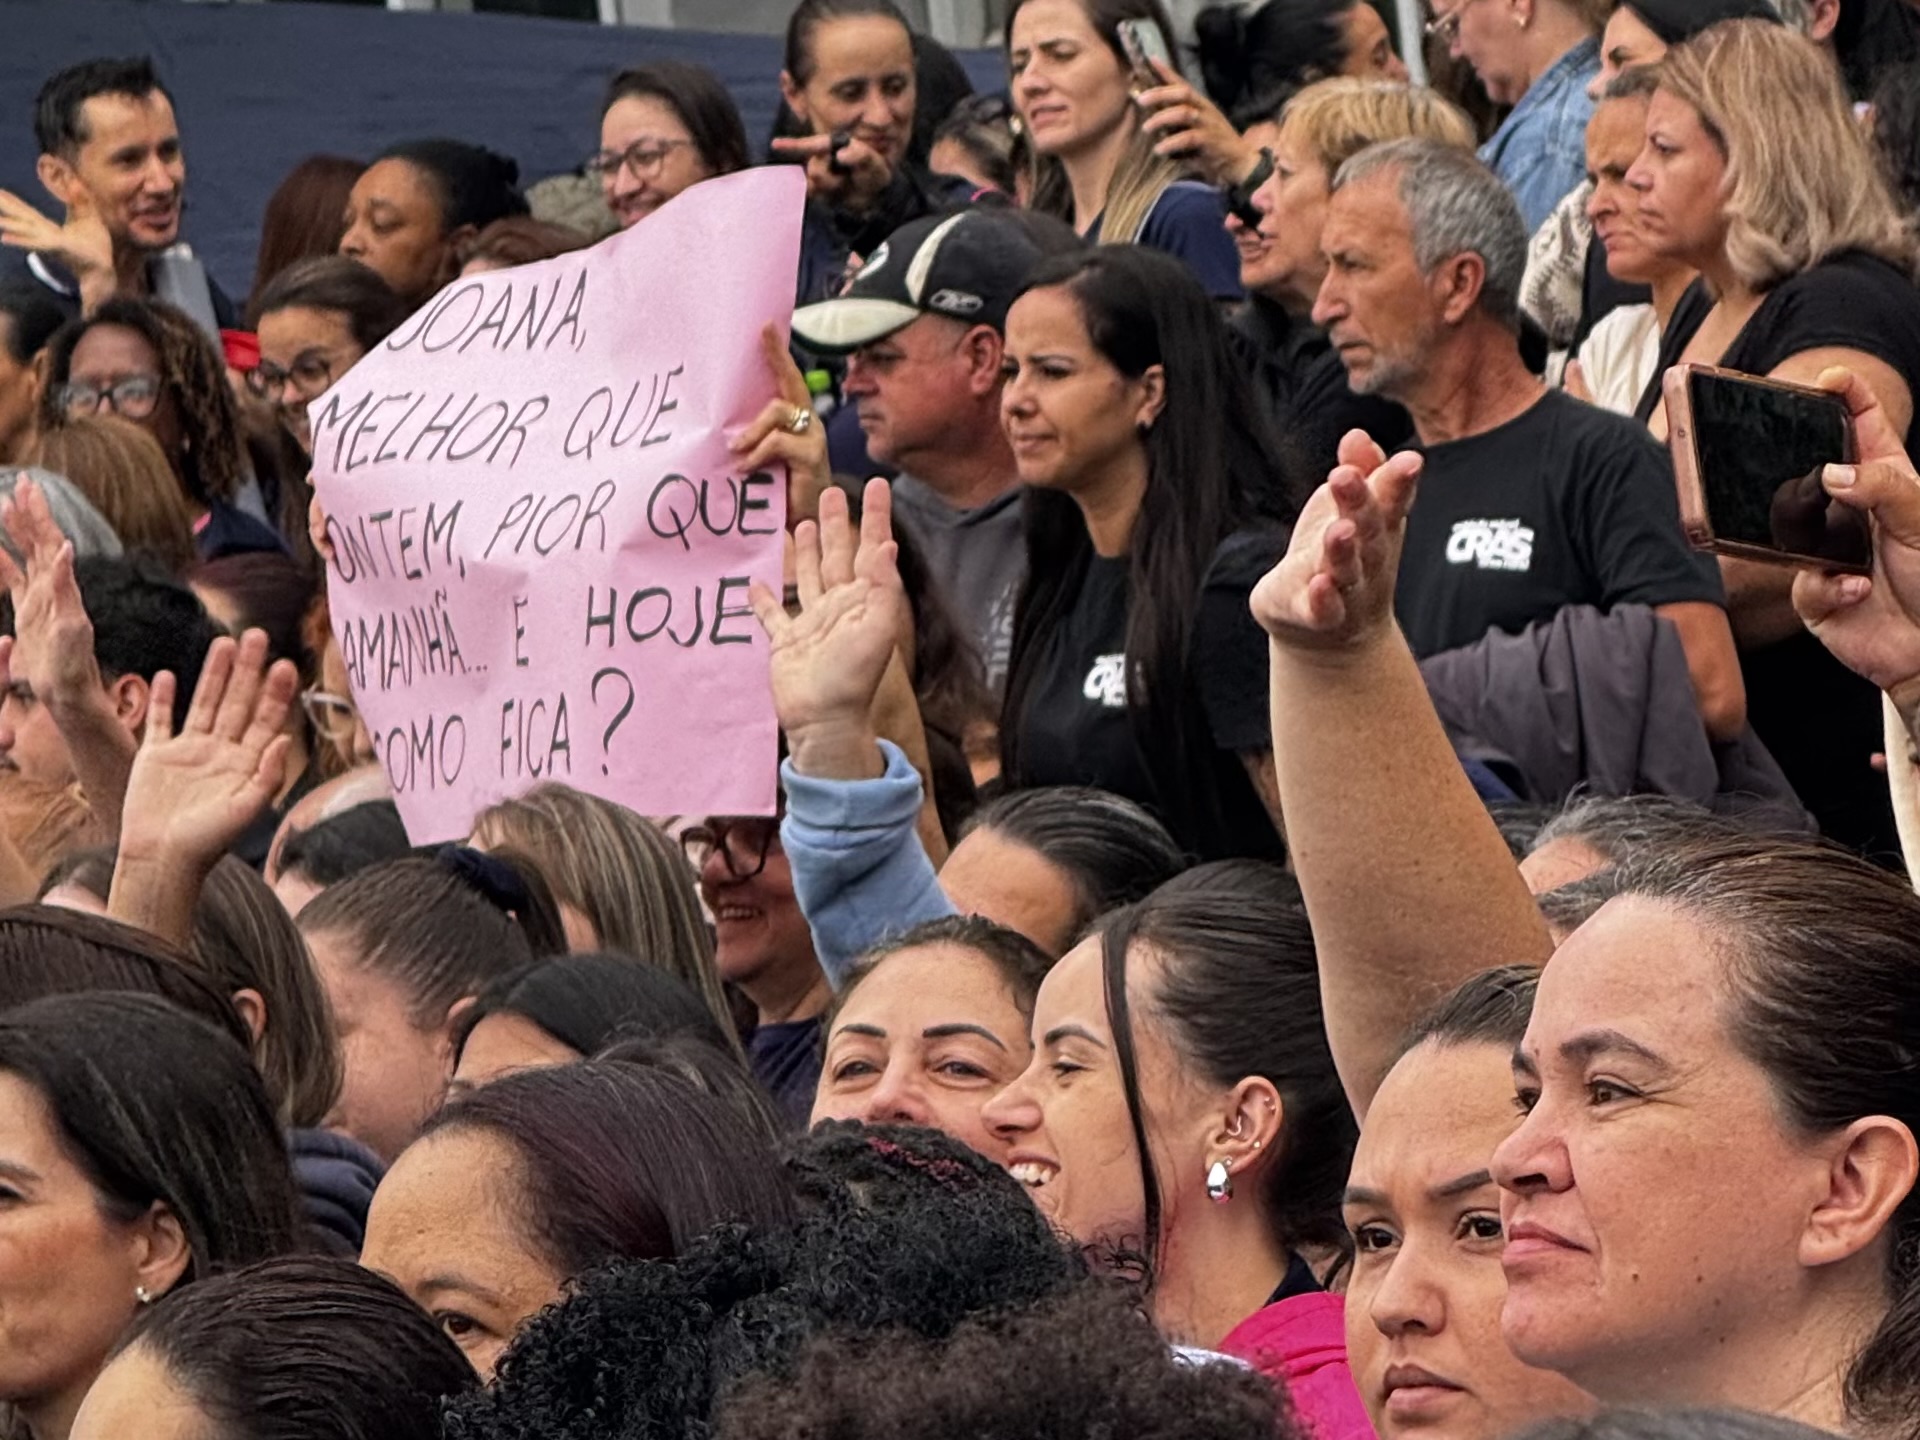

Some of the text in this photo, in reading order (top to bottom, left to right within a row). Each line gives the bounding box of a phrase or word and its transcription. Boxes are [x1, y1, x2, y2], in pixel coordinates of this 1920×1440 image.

[386, 267, 588, 354] JOANA,
[313, 363, 684, 474] MELHOR QUE
[325, 472, 778, 584] ONTEM, PIOR QUE
[1446, 526, 1534, 563] CRAS
[584, 576, 755, 647] HOJE
[374, 714, 466, 794] OMO
[500, 692, 572, 779] FICA
